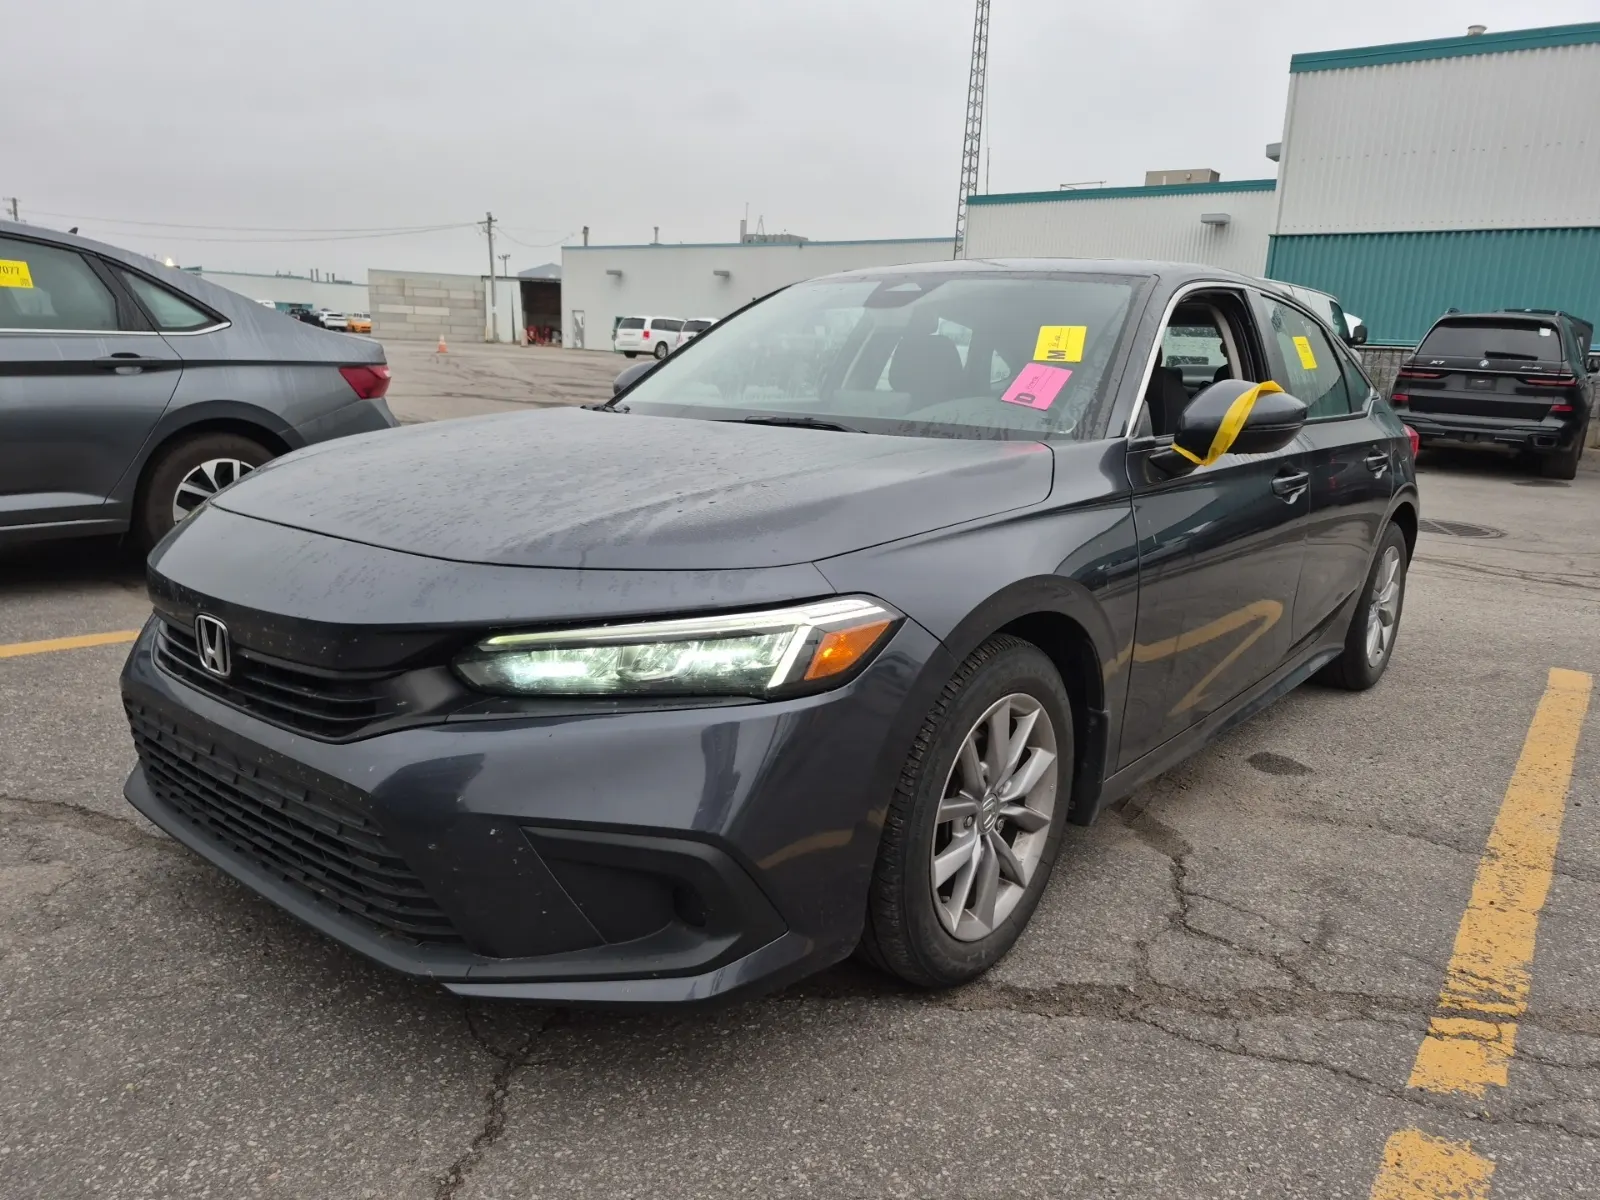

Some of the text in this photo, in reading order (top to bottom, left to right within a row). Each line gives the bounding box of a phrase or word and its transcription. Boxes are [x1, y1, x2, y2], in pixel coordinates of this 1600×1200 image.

[0, 266, 20, 274] 077
[1046, 349, 1067, 360] M
[1014, 392, 1036, 404] D
